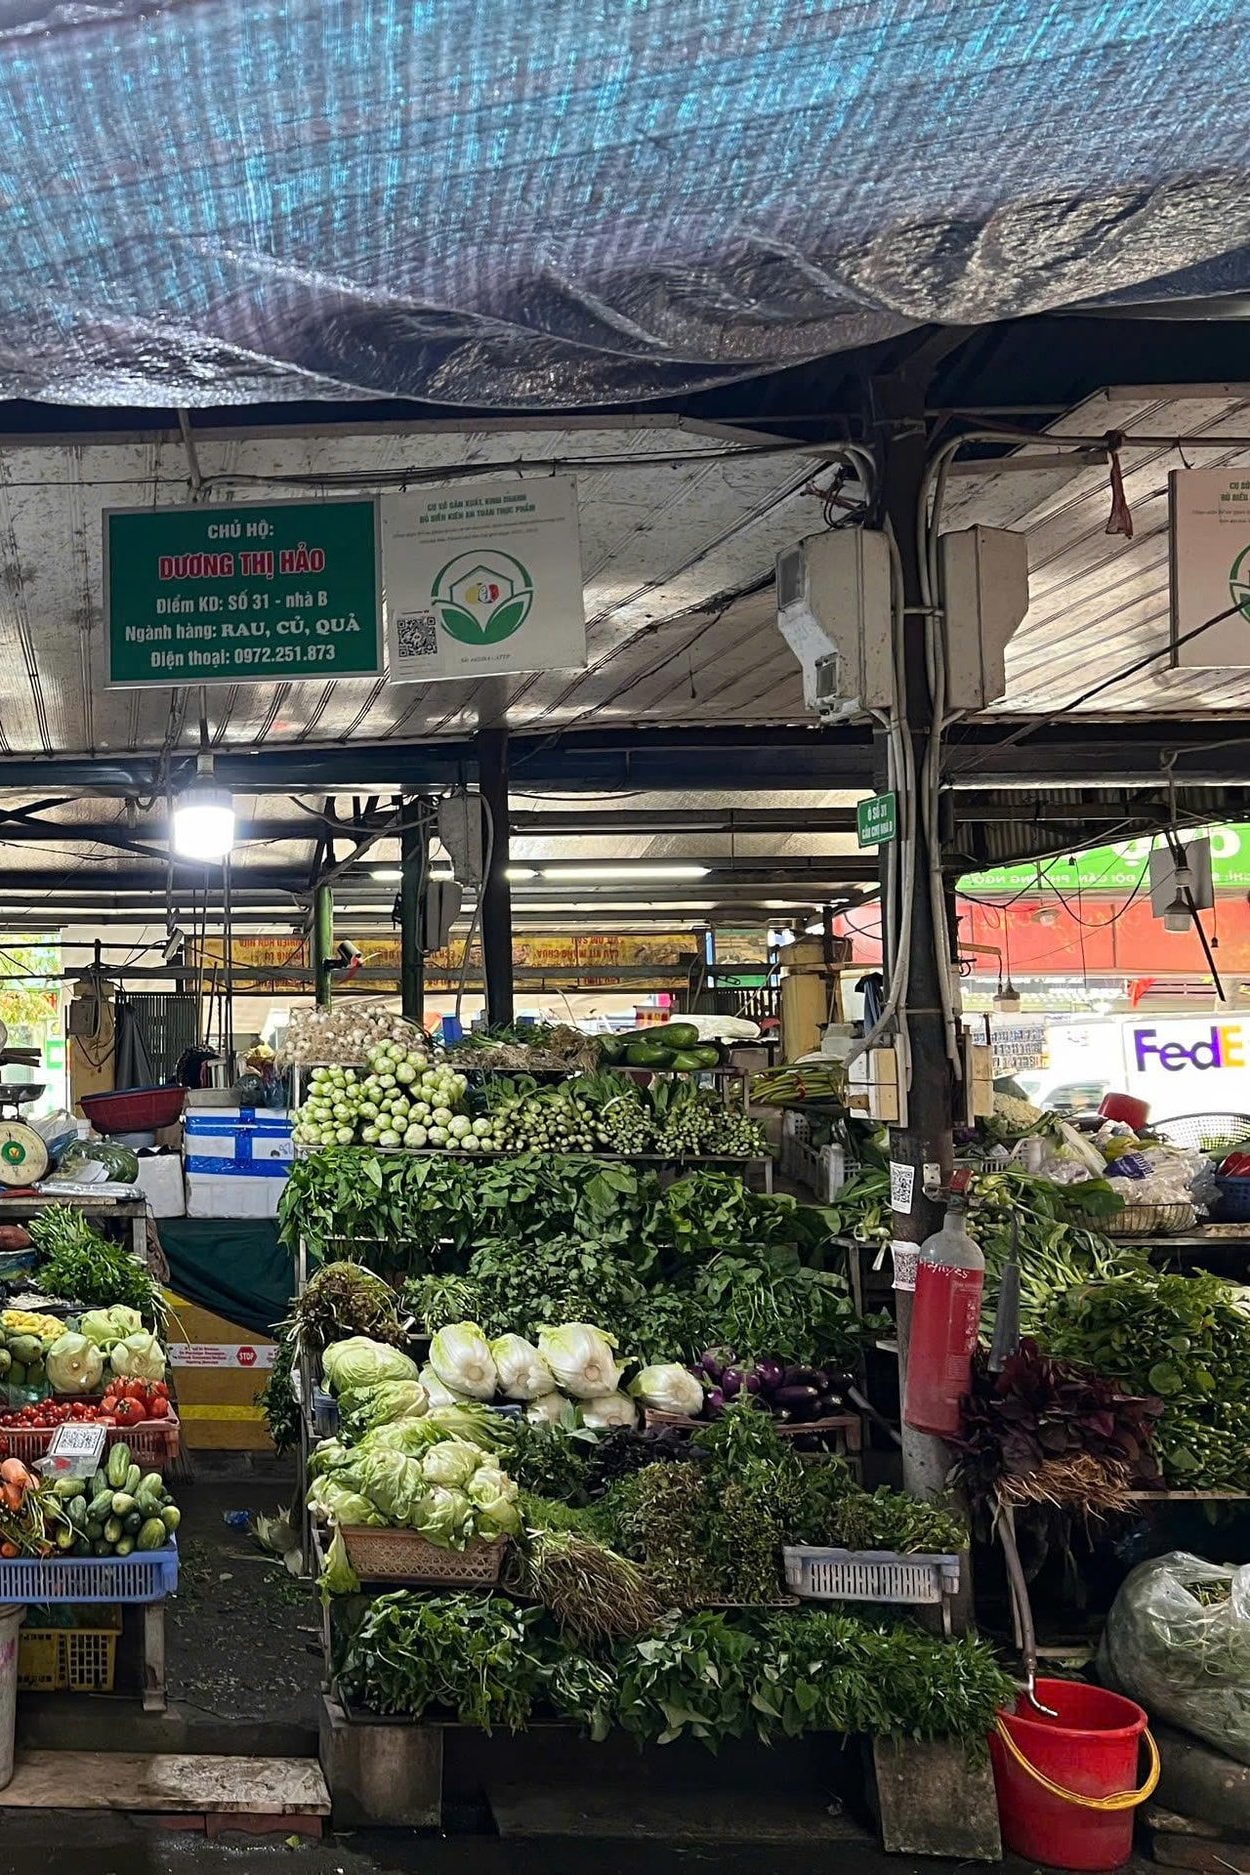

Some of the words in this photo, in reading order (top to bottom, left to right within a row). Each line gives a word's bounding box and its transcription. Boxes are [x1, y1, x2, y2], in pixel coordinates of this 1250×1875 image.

[208, 519, 241, 539] CHỦ
[246, 519, 274, 540] HỘ:
[158, 551, 234, 580] DƯƠNG
[238, 551, 274, 580] THỊ
[279, 541, 326, 574] HẢO
[156, 594, 194, 614] Điểm
[228, 589, 248, 611] SỐ
[252, 594, 270, 610] 31
[285, 591, 313, 608] nhà
[318, 591, 328, 606] B
[125, 624, 172, 644] Ngành
[176, 624, 217, 641] hàng:
[221, 622, 271, 638] RAU,
[276, 616, 310, 637] CỦ,
[315, 613, 361, 635] QUẢ
[150, 650, 184, 668] Điện
[188, 649, 230, 668] thoại:
[234, 644, 336, 664] 0972.251.873
[238, 1352, 254, 1360] STOP
